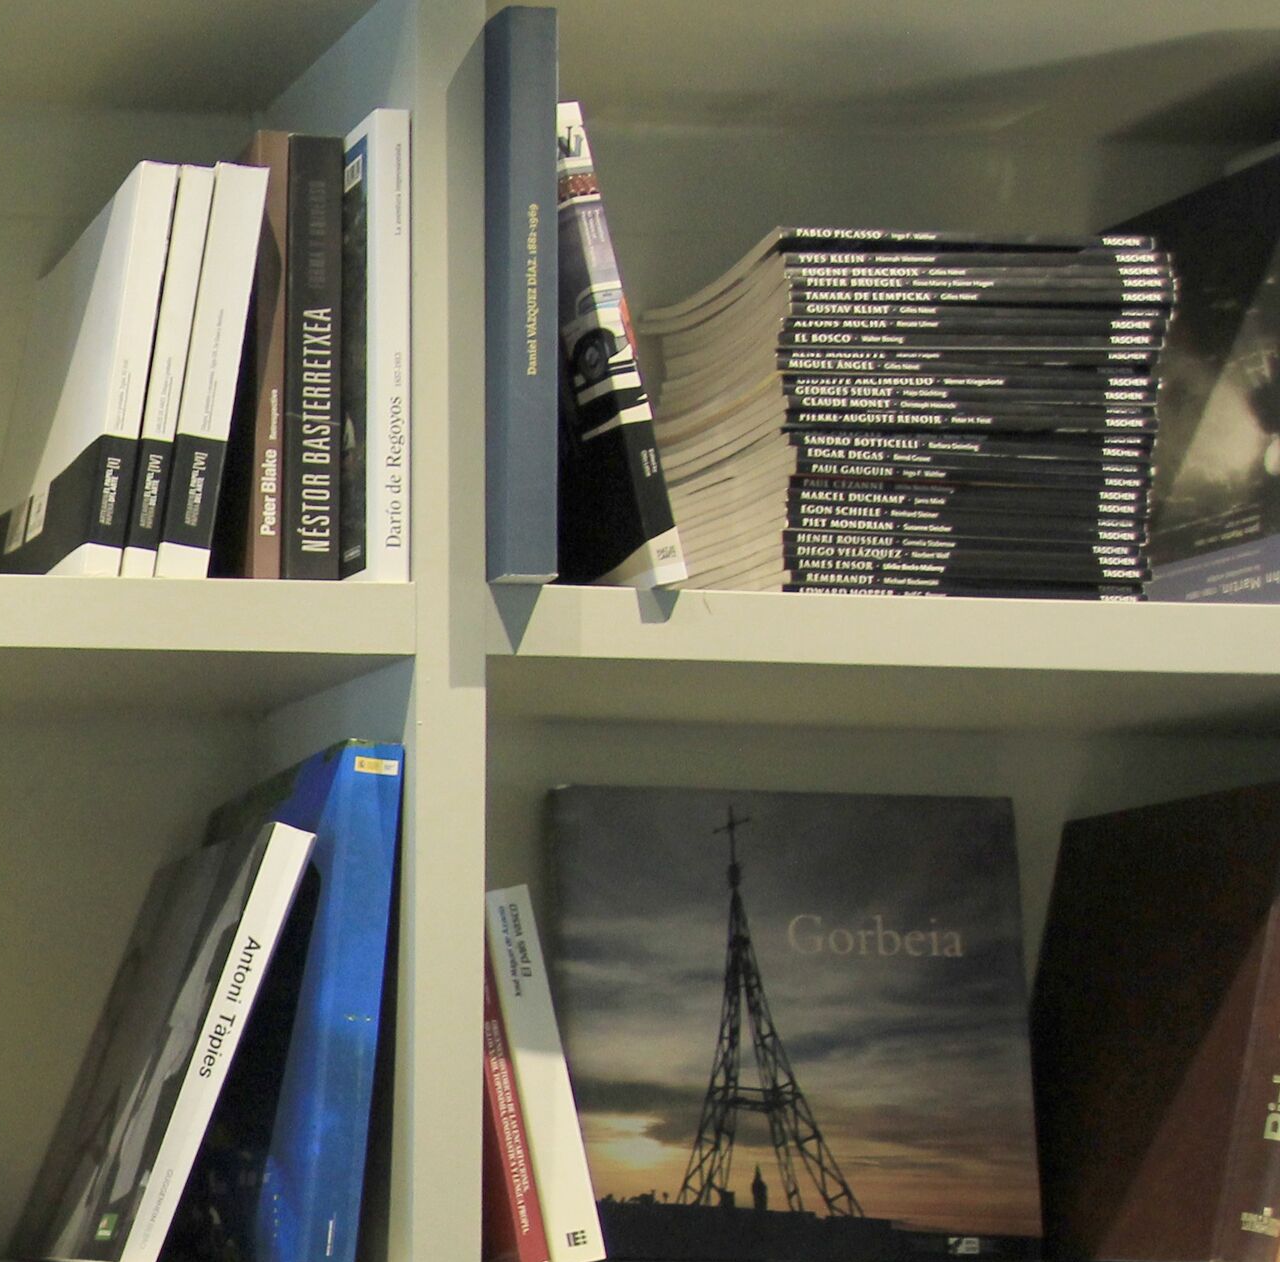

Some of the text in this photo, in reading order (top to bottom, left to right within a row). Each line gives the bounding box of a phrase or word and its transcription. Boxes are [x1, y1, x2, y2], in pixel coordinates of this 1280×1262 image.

[796, 229, 881, 239] PABLO PICASSO
[1102, 237, 1141, 246] TASCHEN
[799, 255, 865, 263] YVES KLEIN
[794, 333, 851, 343] EL BOSCO
[297, 307, 332, 551] NÉSTOR BASTERRETXEA
[807, 448, 884, 460] EDGAR DEGAS
[384, 396, 405, 547] Darío de Regoyos
[260, 448, 277, 535] Peter Blake
[797, 546, 902, 560] DIEGO VELÁZQUEZ
[806, 573, 874, 585] REMBRANDT
[788, 914, 965, 957] Gorbeia
[198, 935, 261, 1078] Antoni Tàpies
